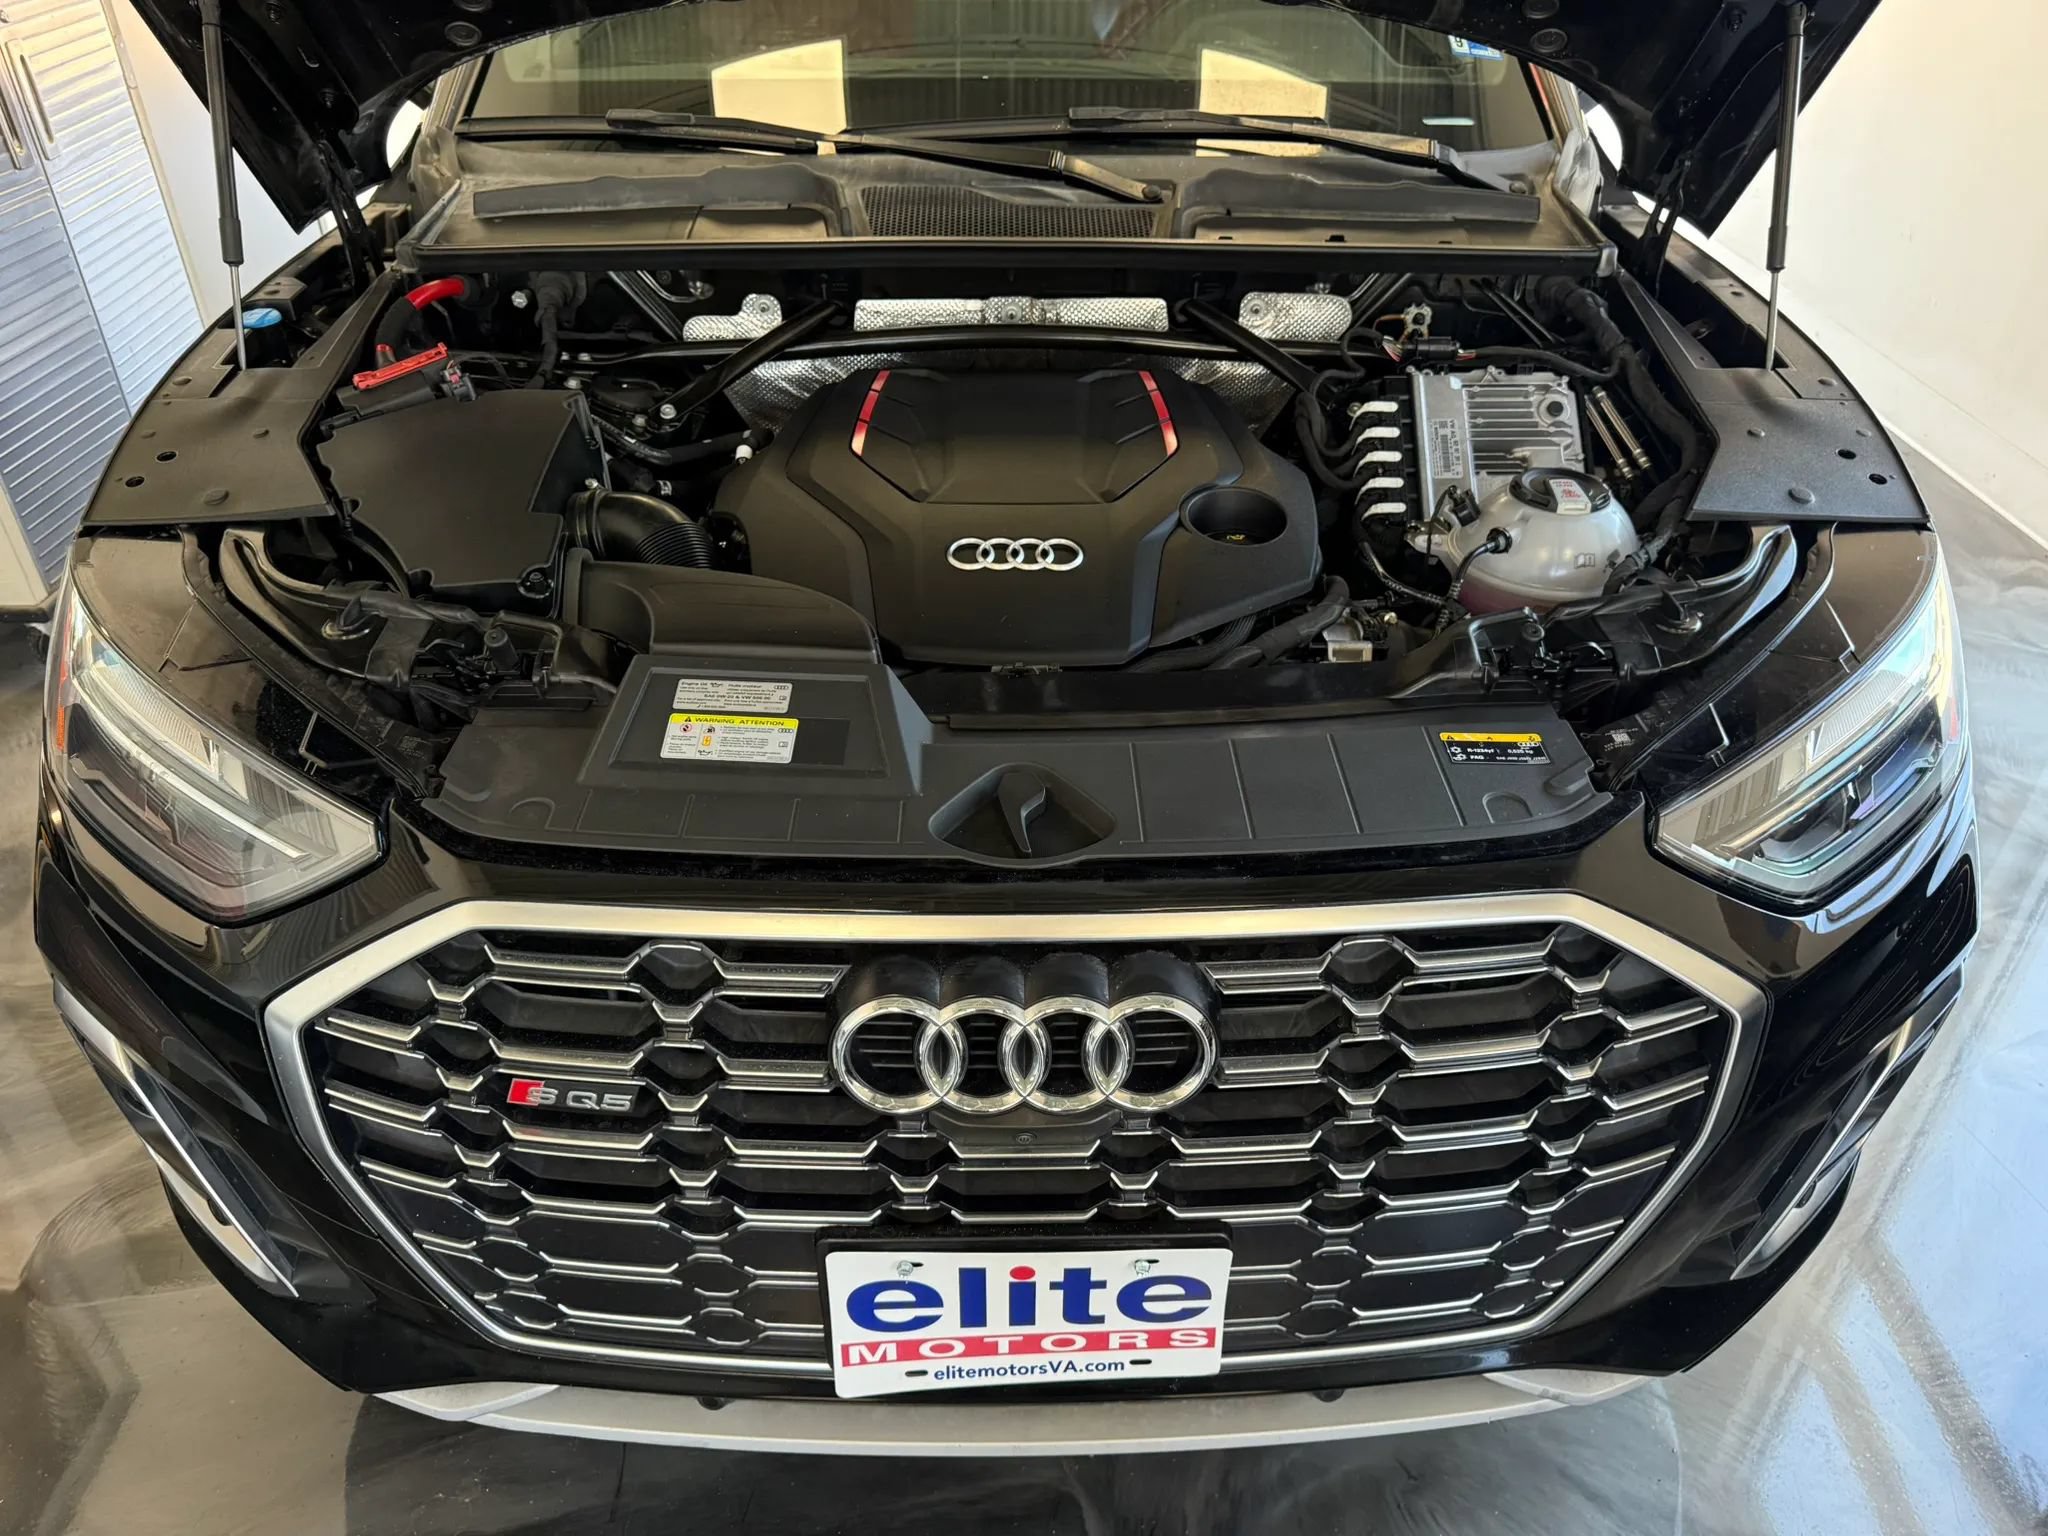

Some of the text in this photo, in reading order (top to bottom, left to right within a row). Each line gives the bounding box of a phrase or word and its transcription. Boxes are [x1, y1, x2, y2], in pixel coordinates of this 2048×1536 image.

[846, 1265, 1212, 1333] elite
[848, 1329, 1210, 1364] MOTORS
[933, 1358, 1125, 1381] elitemotorsVA.com
